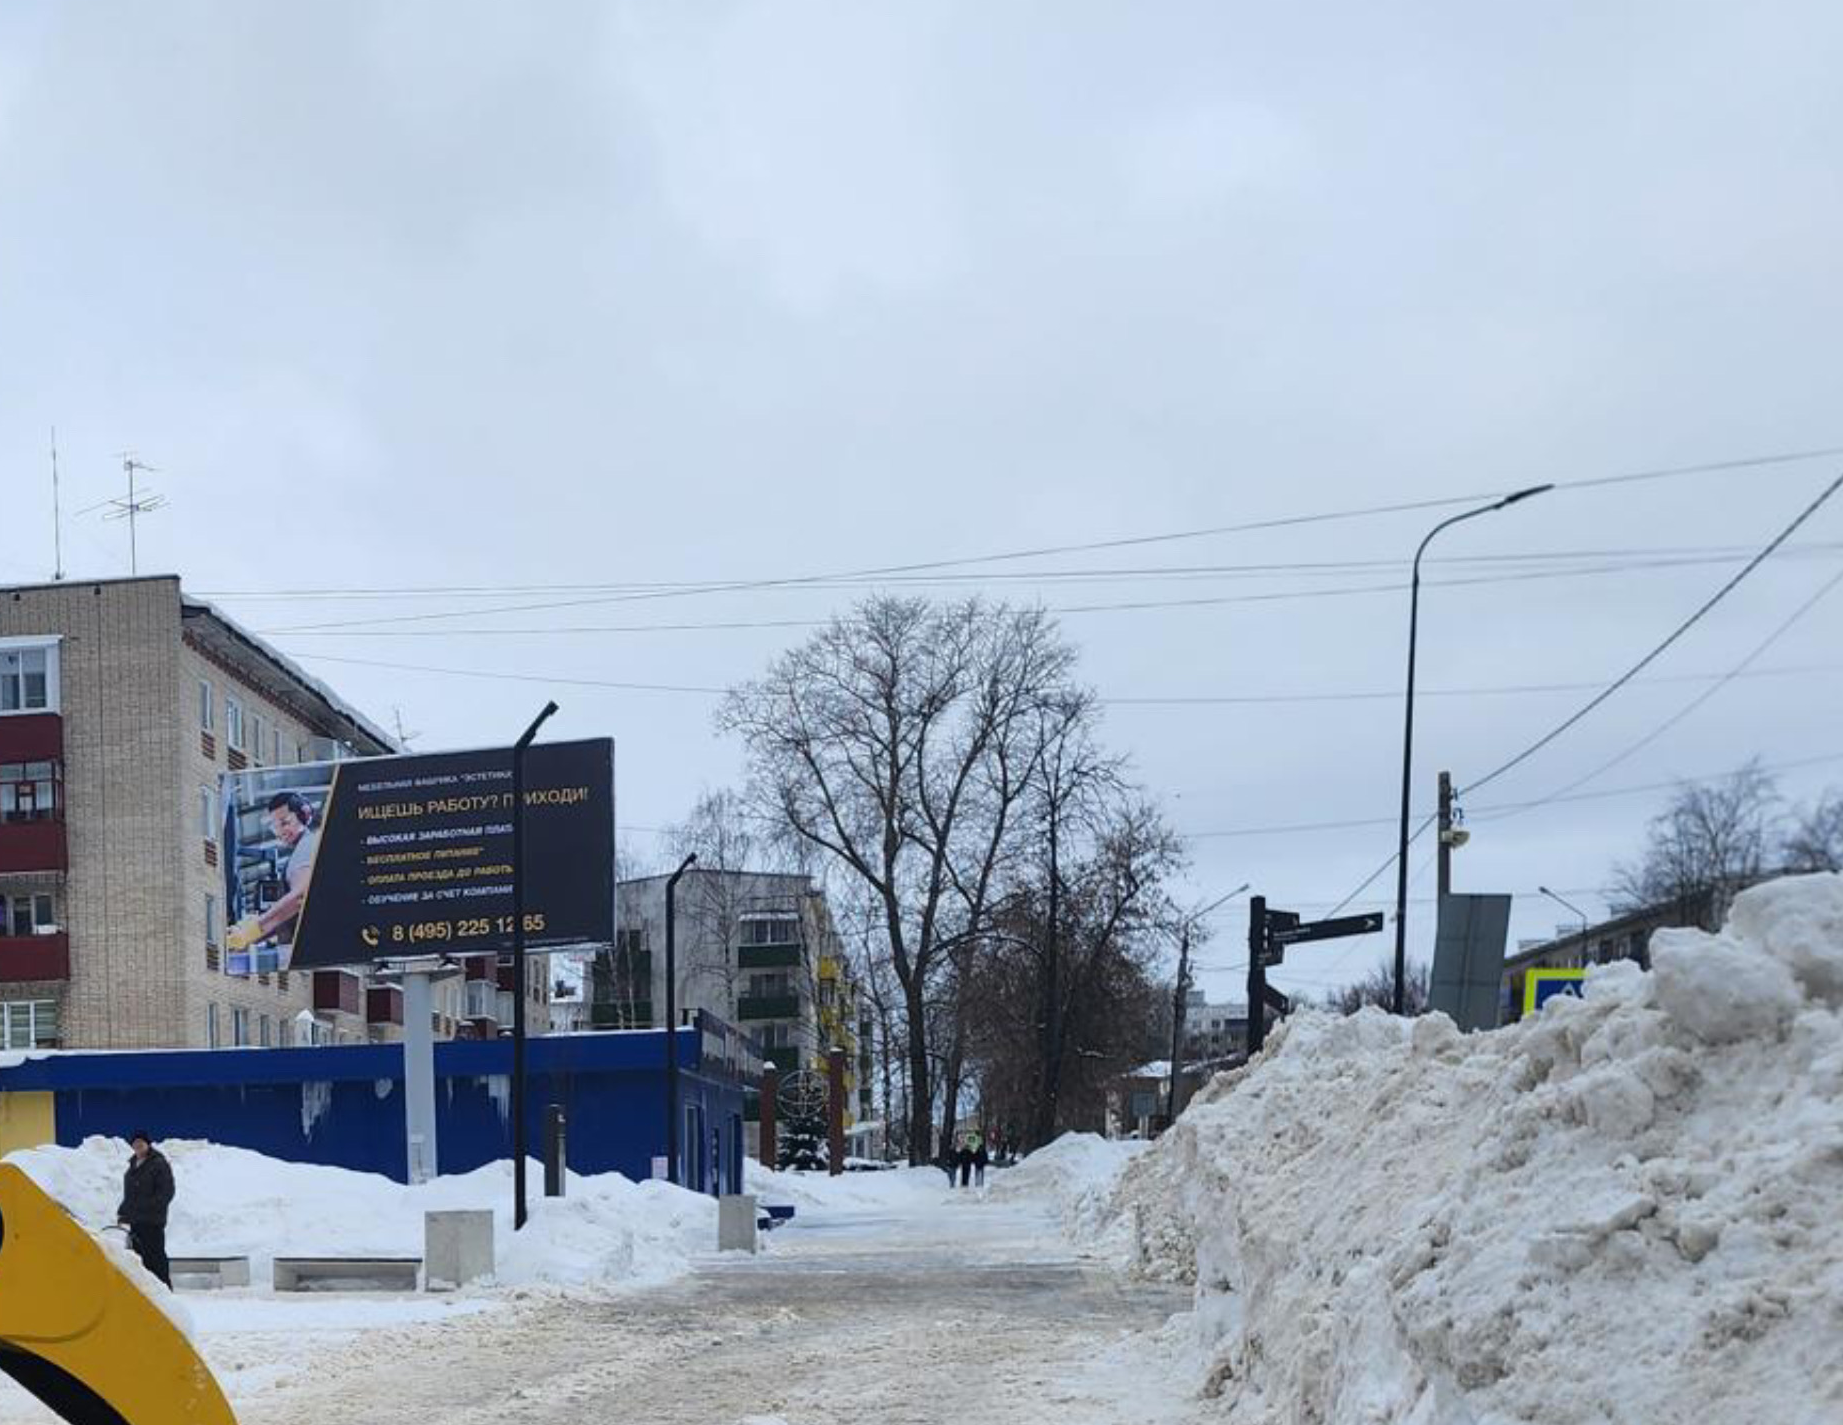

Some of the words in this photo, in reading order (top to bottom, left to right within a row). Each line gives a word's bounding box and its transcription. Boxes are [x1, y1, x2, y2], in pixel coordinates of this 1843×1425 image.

[358, 801, 422, 821] ИЩЕШЬ
[427, 794, 498, 814] РАБОТУ?
[503, 786, 588, 808] ПИХОДИ!
[367, 832, 414, 845] ВЫСОКАЯ
[417, 826, 483, 840] ЗАРАБОТНАЯ
[484, 823, 514, 834] ПЛАТ
[367, 850, 430, 865] БЕСПЛАТНОЕ
[367, 873, 405, 885] ОПЛАТА
[407, 869, 454, 881] ПРОЕЗДА
[456, 867, 471, 877] ДО
[367, 892, 418, 905] ОБУЧЕНИЕ
[422, 890, 434, 900] ЗА
[436, 888, 460, 899] СЧЕТ
[392, 926, 404, 941] 8
[408, 921, 451, 943] (495)
[457, 918, 489, 936] 225
[523, 914, 544, 930] 65
